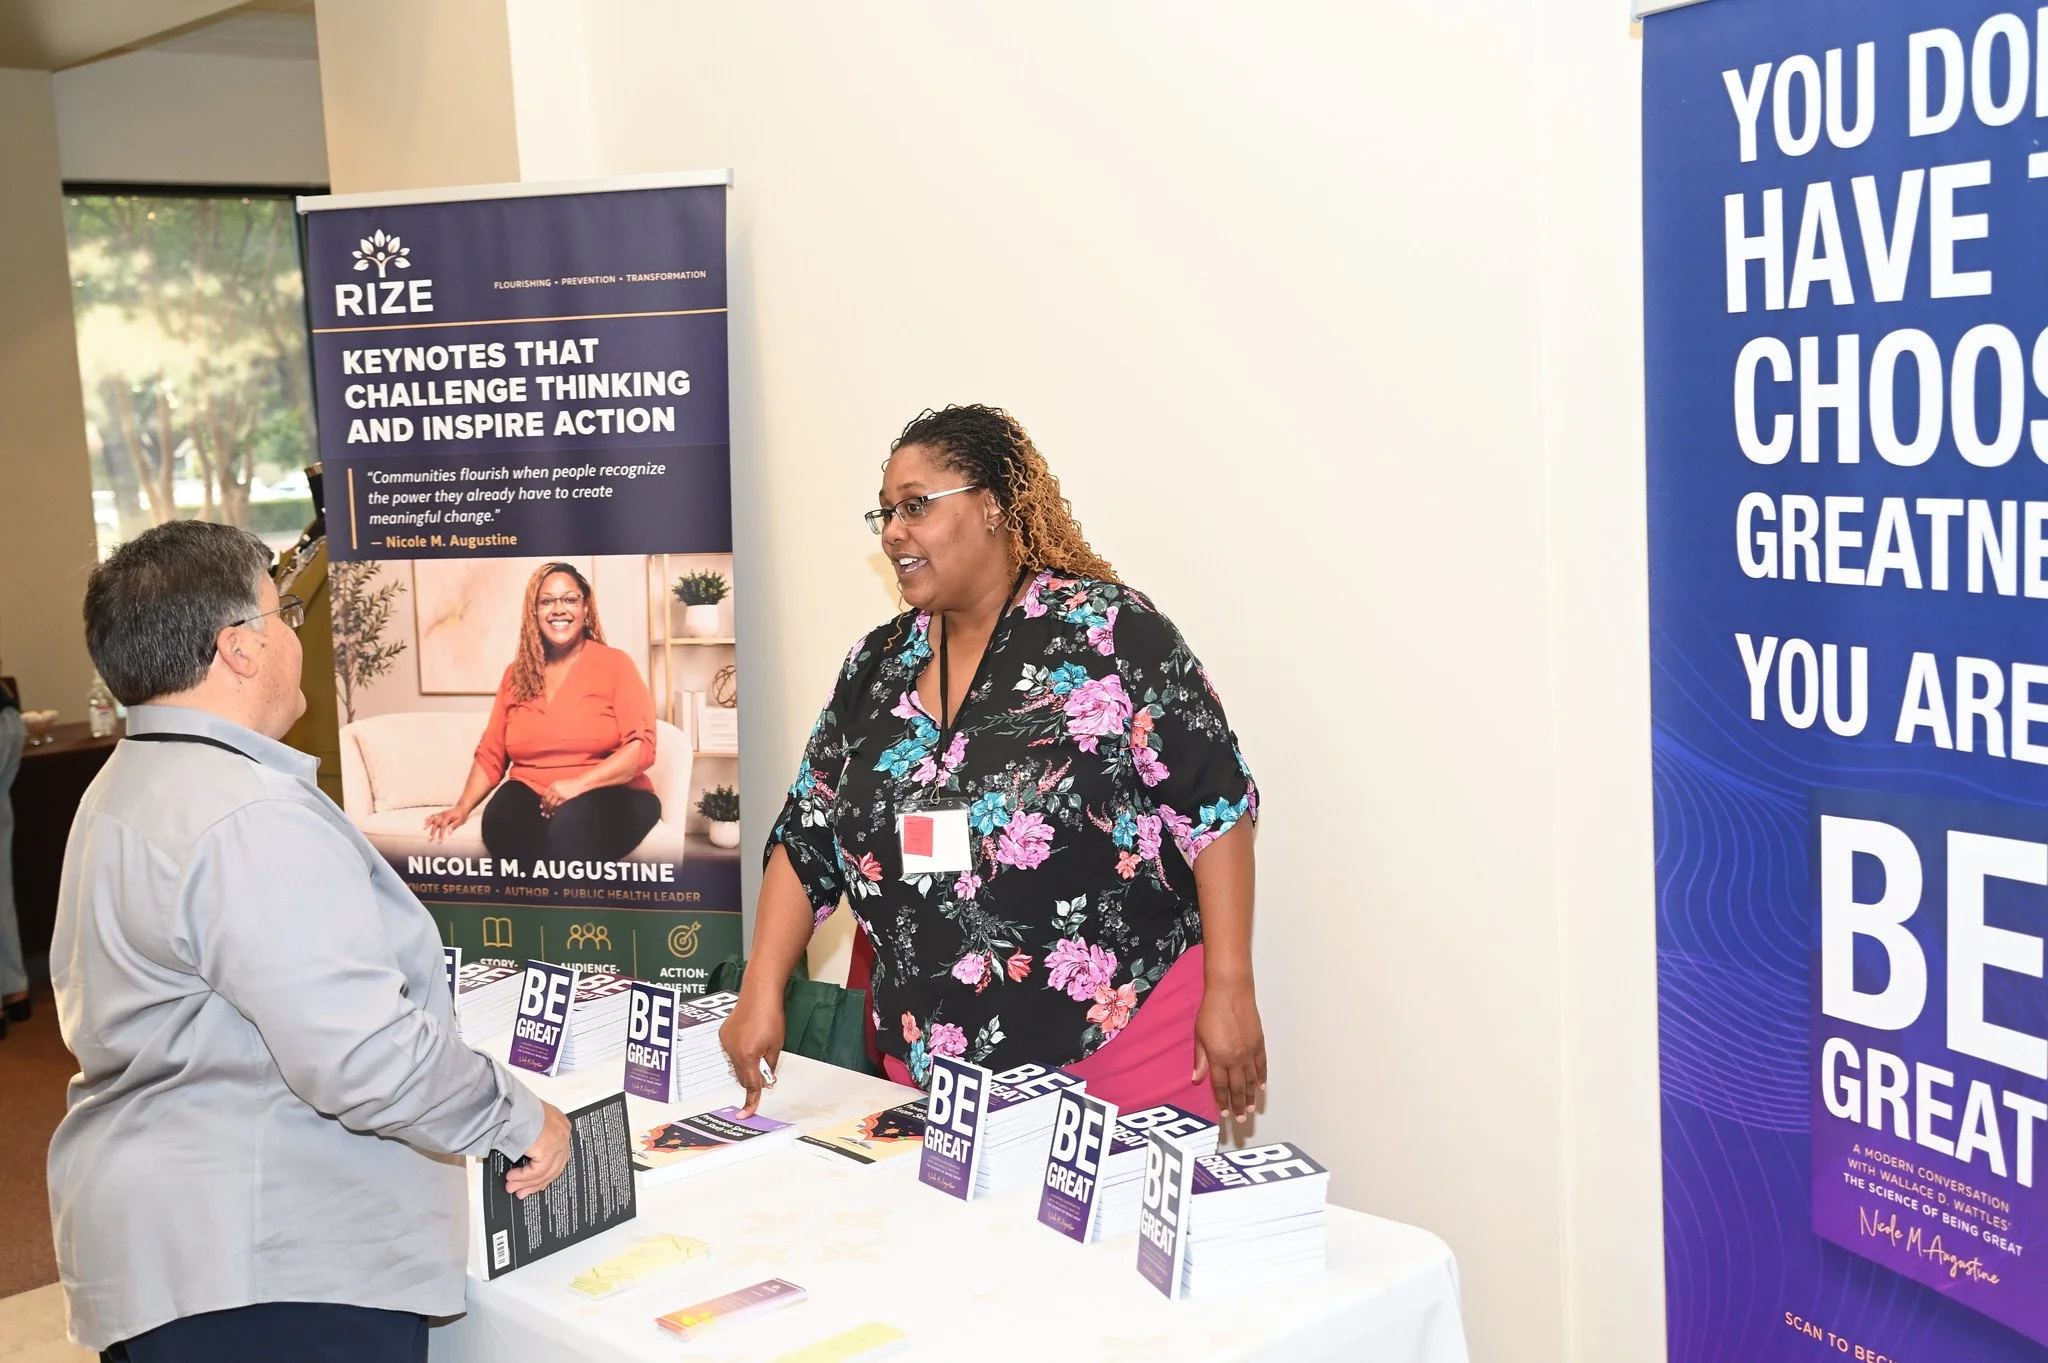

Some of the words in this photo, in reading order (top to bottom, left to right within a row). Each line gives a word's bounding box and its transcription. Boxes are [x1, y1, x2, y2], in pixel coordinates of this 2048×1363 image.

[1722, 41, 1875, 163] YOU
[1909, 7, 2048, 137] DO
[1724, 160, 1992, 313] HAVE
[335, 279, 434, 316] RIZE
[494, 279, 552, 290] FLOURISHING
[561, 275, 616, 286] PREVENTION
[626, 270, 707, 282] TRANSFORMATION
[343, 342, 506, 375] KEYNOTES
[515, 338, 599, 366] THAT
[345, 376, 527, 410] CHALLENGE
[536, 370, 691, 401] THINKING
[1734, 323, 2048, 467] CHOO
[347, 418, 413, 444] AND
[423, 411, 544, 442] INSPIRE
[554, 406, 675, 437] ACTION
[367, 468, 456, 485] “Communities
[460, 466, 510, 482] flourish
[513, 467, 549, 480] when
[552, 463, 596, 481] people
[599, 461, 666, 479] recognize
[368, 491, 390, 505] the
[392, 492, 431, 507] power
[435, 489, 464, 505] they
[466, 487, 515, 504] already
[518, 486, 552, 500] have
[555, 487, 569, 499] to
[572, 485, 613, 499] create
[369, 510, 441, 527] meaningful
[444, 508, 501, 526] change.”
[386, 535, 427, 549] Nicole
[430, 536, 446, 547] M.
[449, 533, 518, 549] Augustine
[1735, 632, 1868, 737] YOU
[1895, 651, 2048, 766] ARE
[407, 856, 493, 877] NICOLE
[500, 859, 526, 878] M.
[532, 860, 675, 883] AUGUSTINE
[408, 882, 440, 893] NOTE
[442, 884, 492, 895] SPEAKER
[505, 886, 549, 898] AUTHOR
[563, 888, 605, 900] PUBLIC
[608, 889, 650, 902] HEALTH
[653, 891, 701, 903] LEADER
[1821, 814, 2048, 1080] BE
[660, 967, 709, 979] ACTION-
[520, 967, 570, 1024] BE
[516, 1017, 561, 1046] GREAT
[629, 989, 672, 1048] BE
[627, 1042, 669, 1072] GREAT
[990, 1082, 1030, 1102] REAT
[991, 1063, 1076, 1097] BE
[928, 1064, 979, 1137] BE
[1821, 1037, 2048, 1188] GREAT
[1052, 1097, 1104, 1176] BE
[1112, 1124, 1149, 1147] REAT
[1116, 1105, 1207, 1139] BE
[924, 1125, 971, 1164] GREAT
[1224, 1143, 1316, 1183] BE
[1046, 1161, 1094, 1204] GREAT
[1143, 1139, 1181, 1227] BE
[1195, 1154, 1250, 1187] GREAT
[1847, 1157, 1876, 1176] WITH
[1880, 1169, 1934, 1200] WALLACE
[1937, 1192, 1948, 1206] D.
[1853, 1143, 1861, 1154] A
[1865, 1147, 1914, 1174] MODERN
[1918, 1167, 2010, 1214] CONVERSATION
[1140, 1208, 1176, 1257] GREAT
[1843, 1172, 1865, 1190] THE
[1868, 1182, 1919, 1211] SCIENCE
[1922, 1204, 1939, 1218] OF
[1942, 1212, 1979, 1237] BEING
[1983, 1230, 2023, 1257] GREAT
[1859, 1206, 1903, 1247] Nicole
[1923, 1234, 2000, 1285] Augustine
[1785, 1311, 1823, 1342] SCAN
[1828, 1331, 1848, 1353] TO
